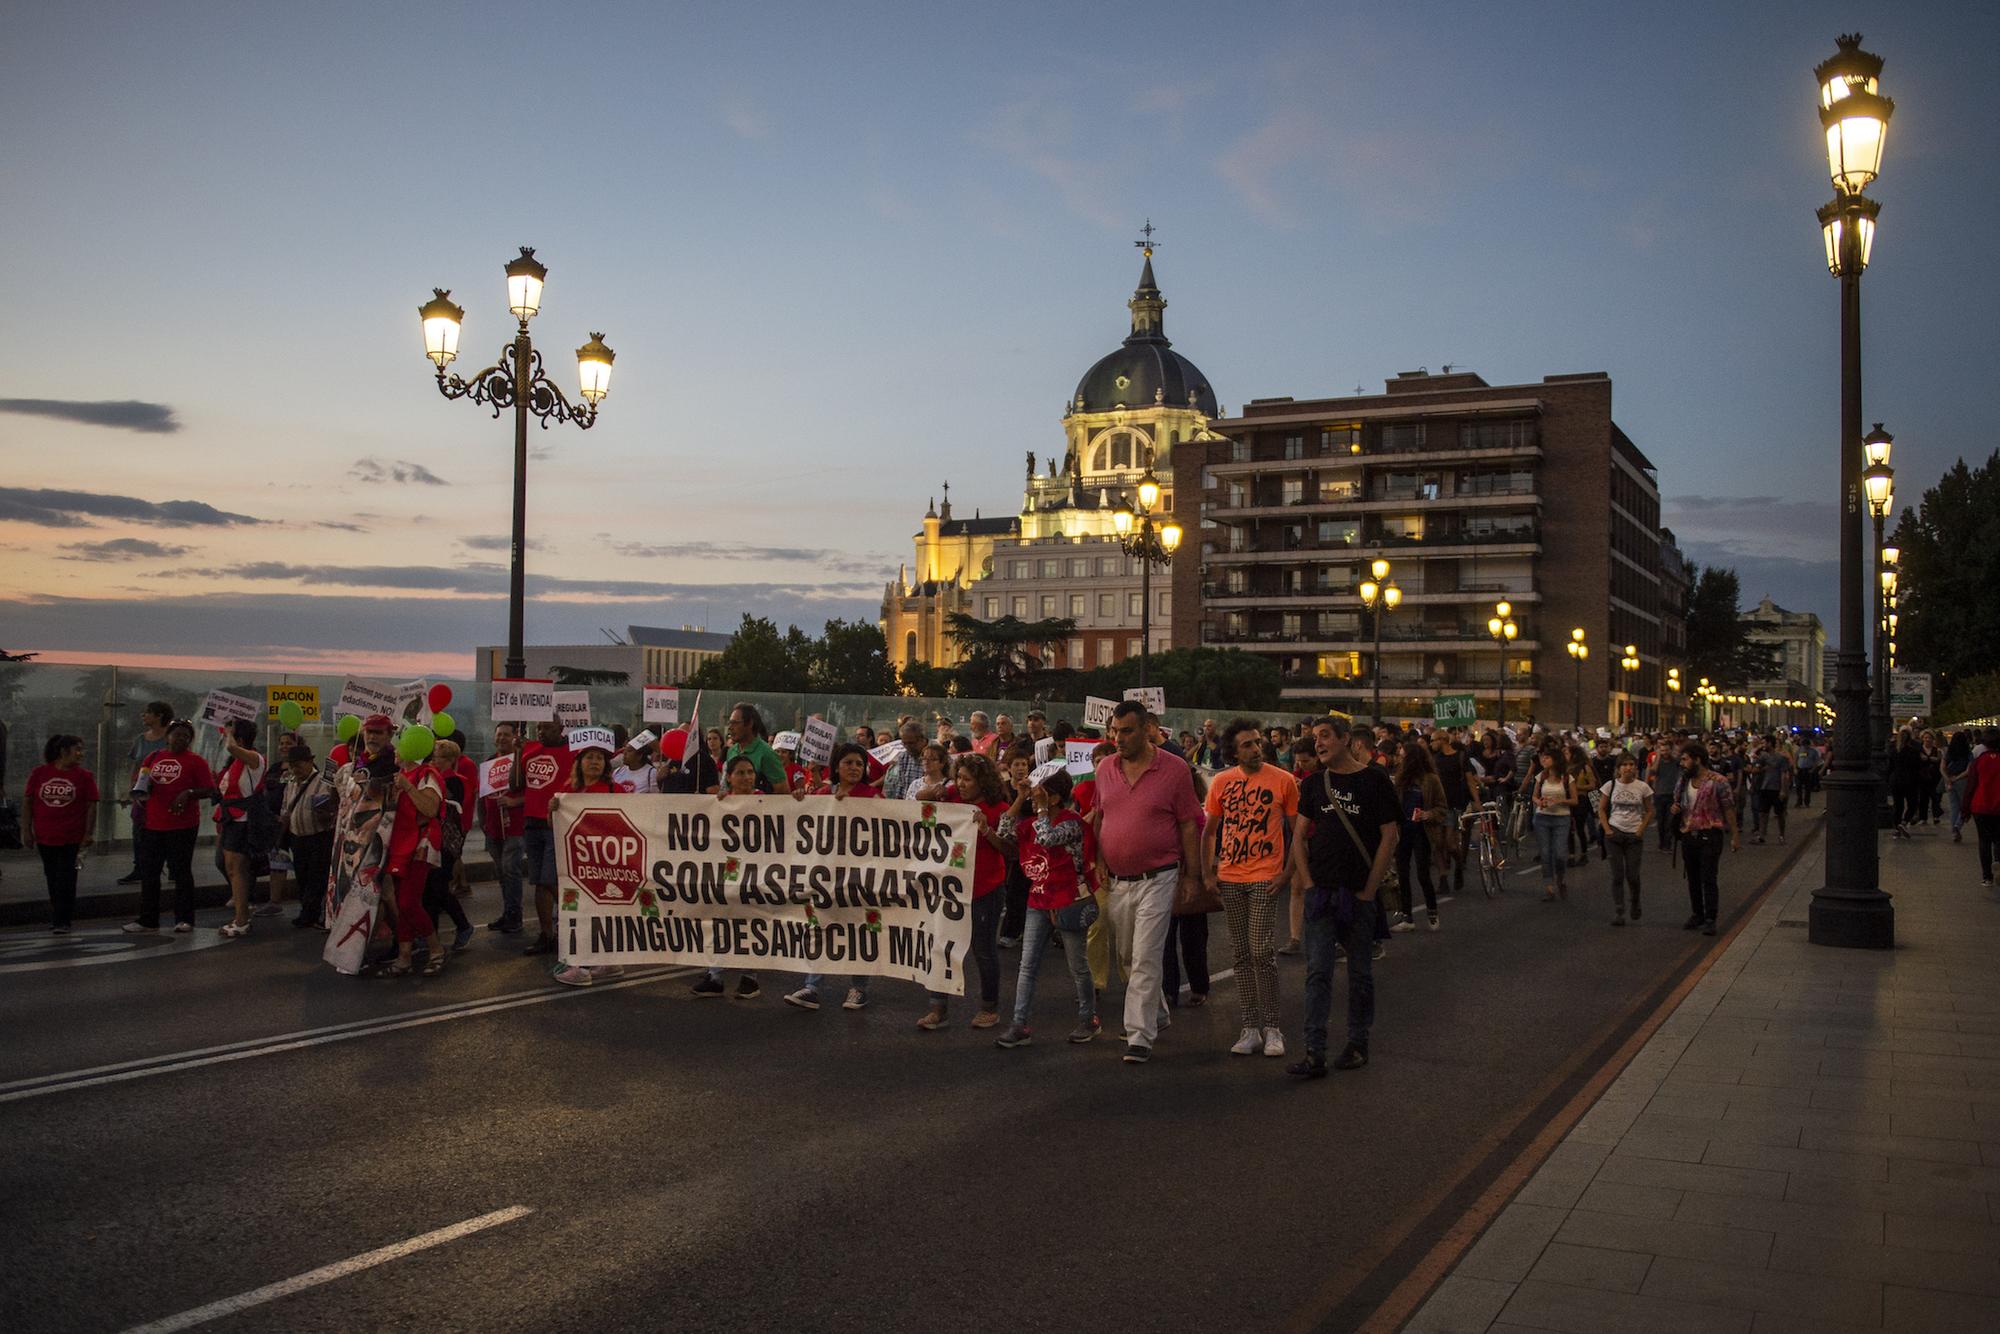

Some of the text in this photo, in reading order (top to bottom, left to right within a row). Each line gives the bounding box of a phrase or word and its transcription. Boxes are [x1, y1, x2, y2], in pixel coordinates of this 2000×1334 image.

[272, 690, 314, 702] DACIÓN
[510, 693, 518, 705] de
[153, 763, 179, 773] STOP
[527, 762, 554, 775] STOP
[43, 784, 72, 795] STOP
[668, 813, 952, 864] NO SON SUICIDIOS
[574, 834, 639, 866] STOP
[577, 865, 641, 883] DESAHUCIOS
[652, 860, 965, 921] SON ASESINATOS
[591, 909, 704, 953] NINGÚN
[712, 917, 879, 962] DESAHUCIO
[888, 921, 934, 976] MÁS
